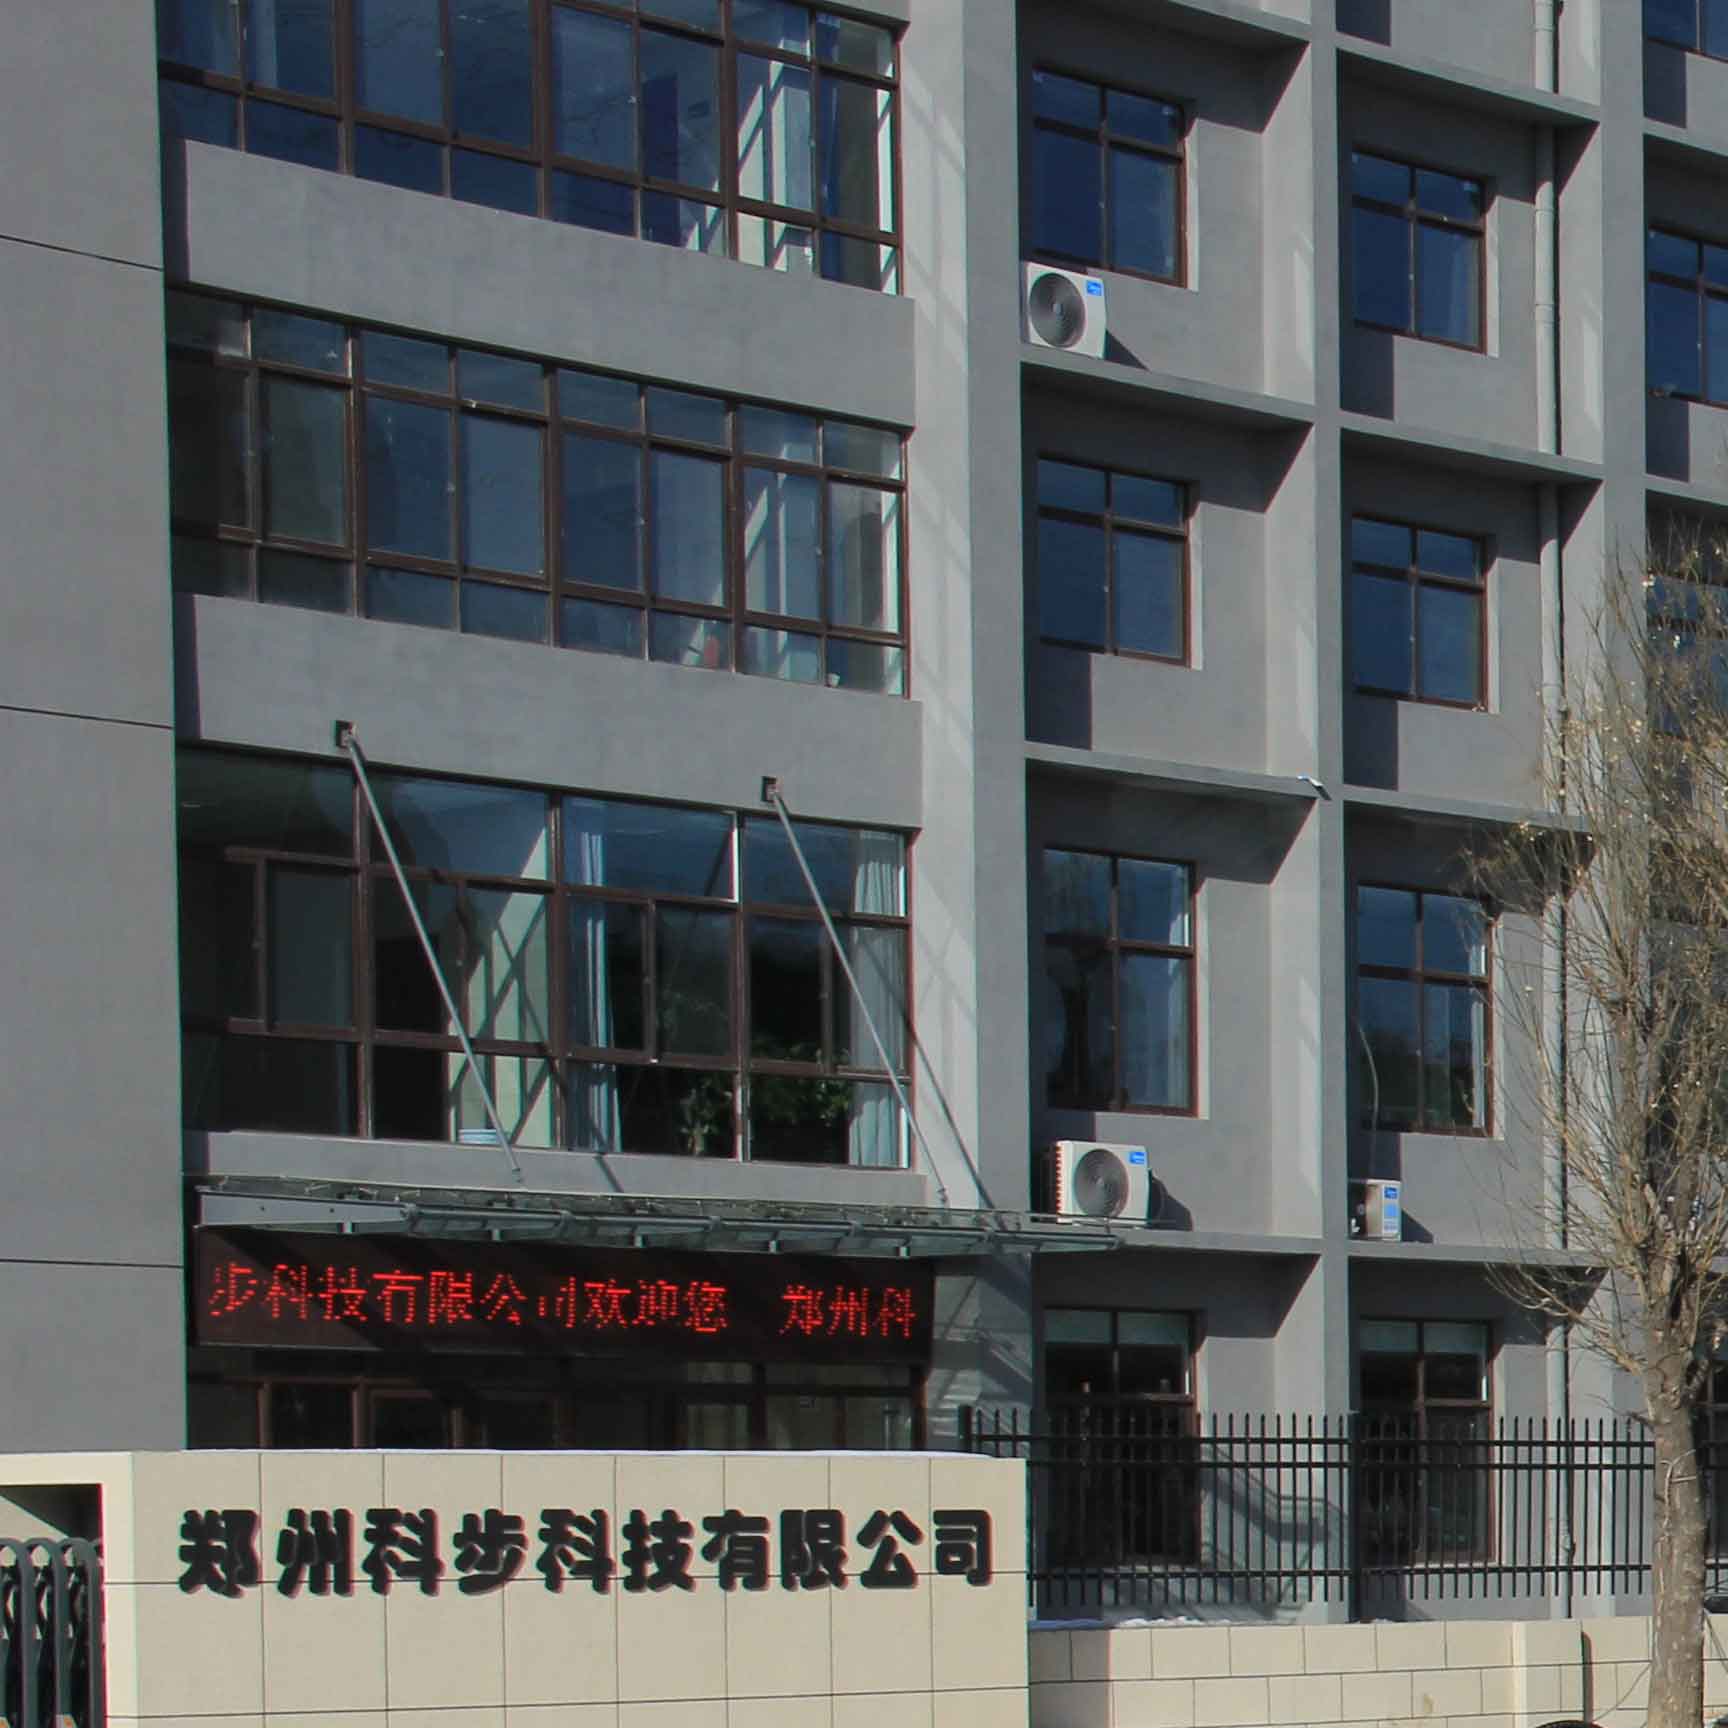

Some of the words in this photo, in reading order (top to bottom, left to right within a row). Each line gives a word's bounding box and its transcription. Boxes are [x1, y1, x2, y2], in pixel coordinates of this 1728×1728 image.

[178, 1508, 992, 1597] 郑州科步科技有限公司
